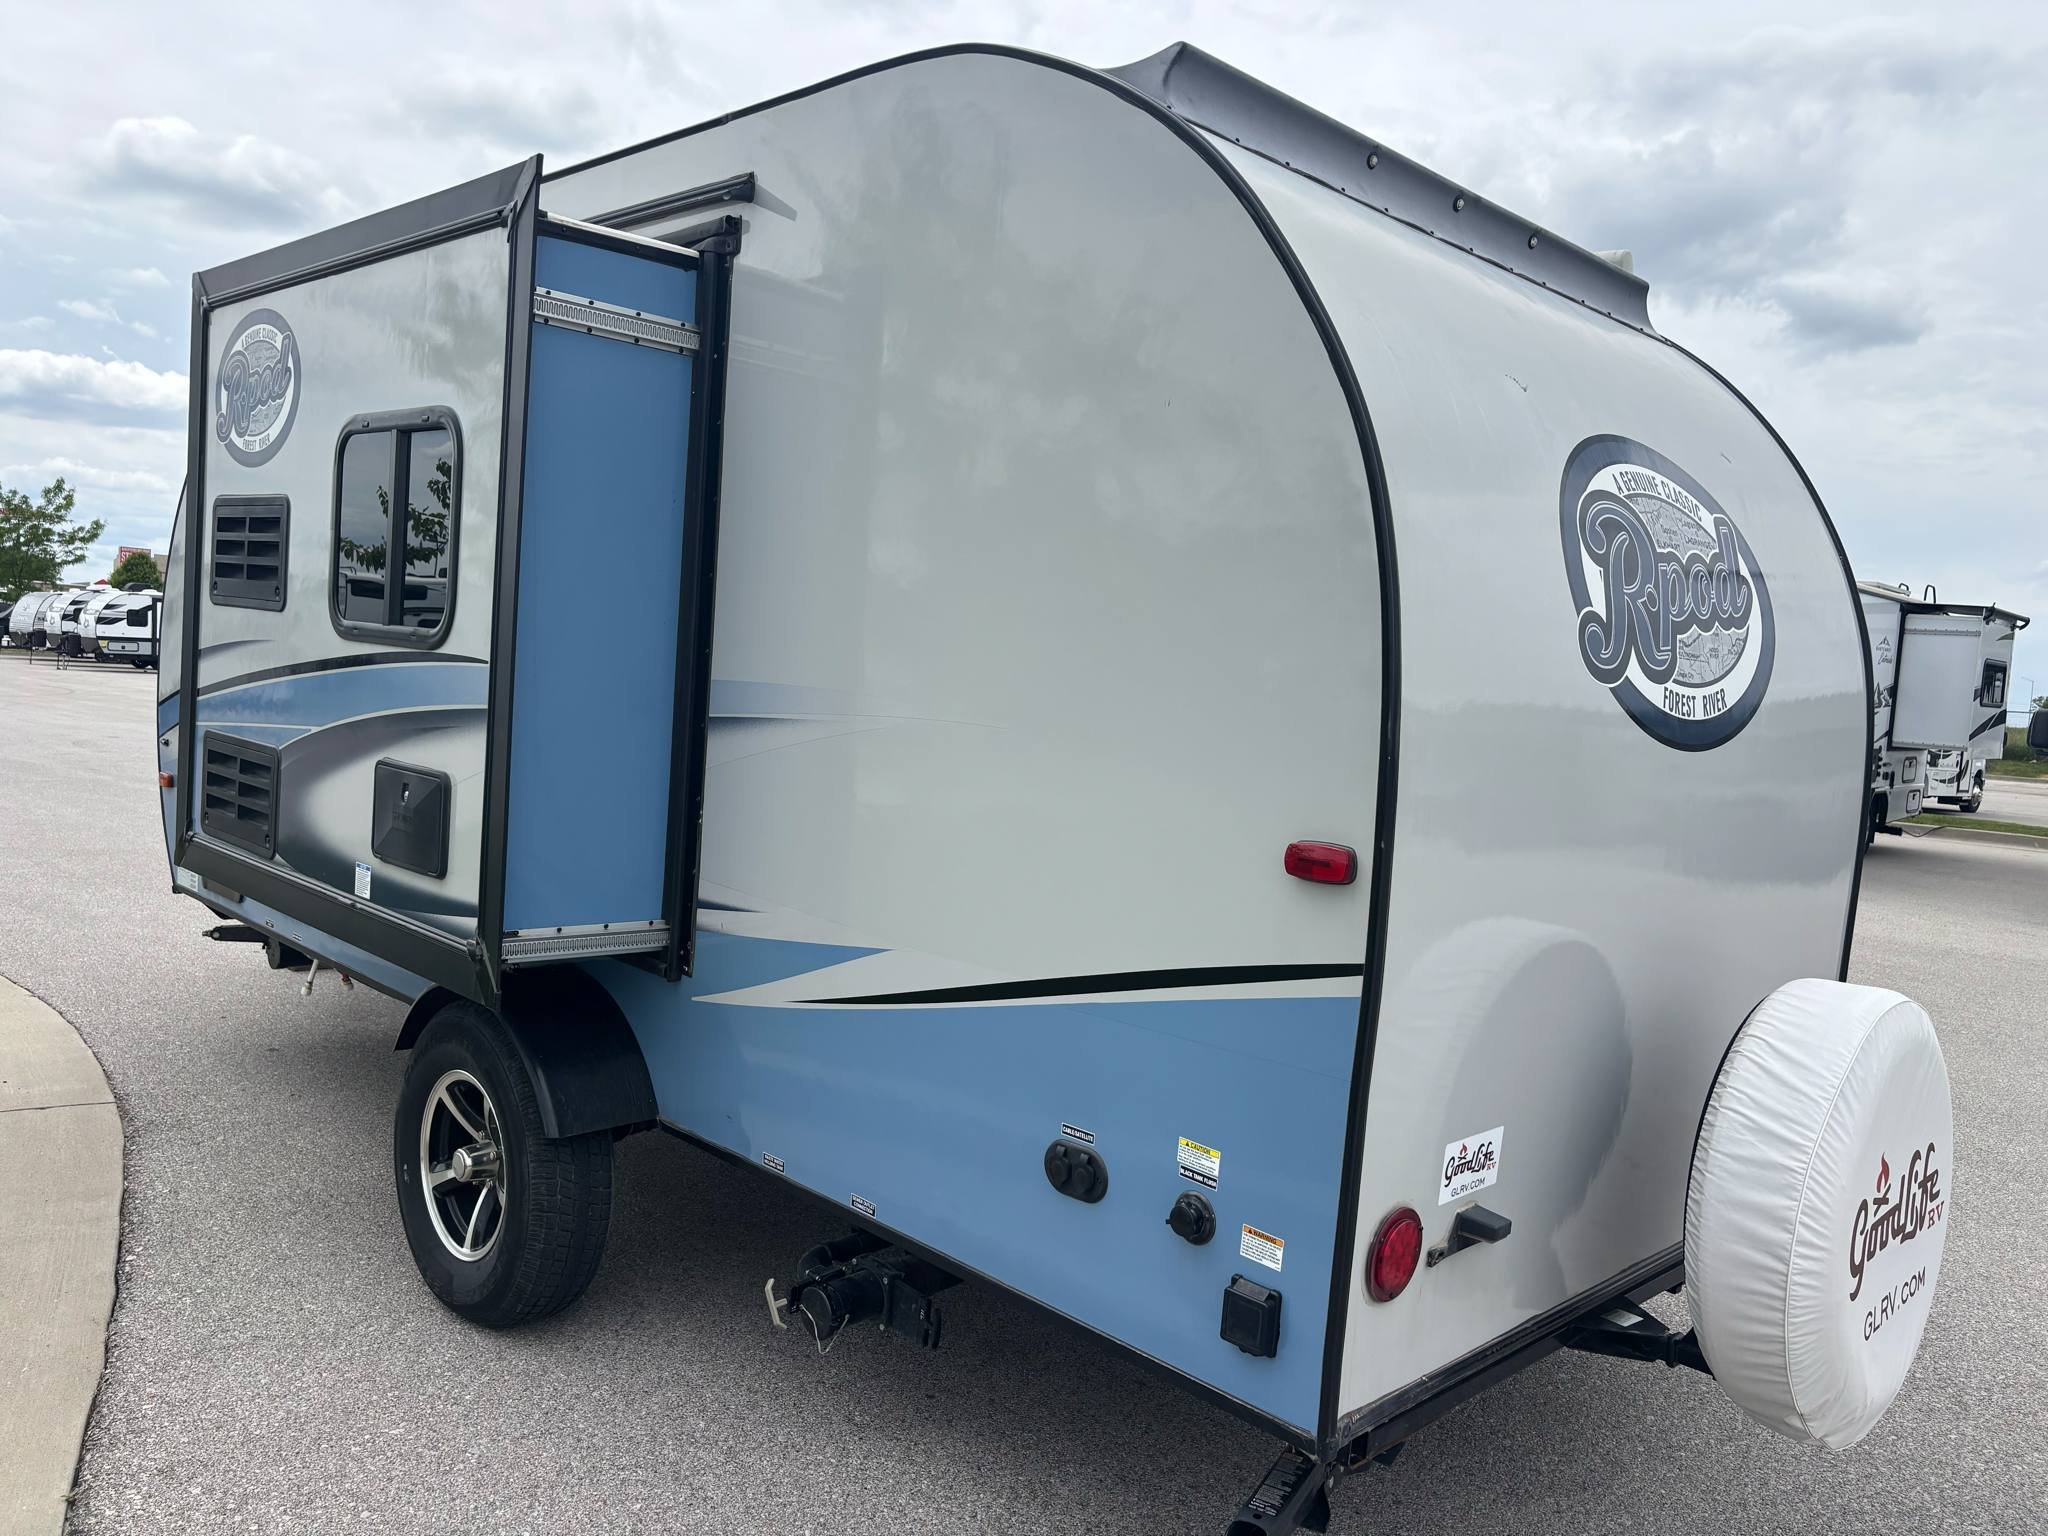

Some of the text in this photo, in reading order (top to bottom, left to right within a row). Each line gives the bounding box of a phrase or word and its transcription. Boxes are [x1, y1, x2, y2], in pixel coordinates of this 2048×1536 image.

[1612, 470, 1702, 522] A GENUINE CLASSIC
[1663, 686, 1728, 718] FOREST RIVER
[1190, 1141, 1211, 1156] CAUTION
[1180, 1168, 1193, 1178] BLACK
[1193, 1172, 1204, 1183] TANK
[1486, 1161, 1497, 1171] RV
[1450, 1177, 1486, 1197] GLRV.COM
[1927, 1200, 1945, 1230] RV
[1253, 1229, 1277, 1246] WARNING
[1863, 1266, 1926, 1342] GLRV.COM
